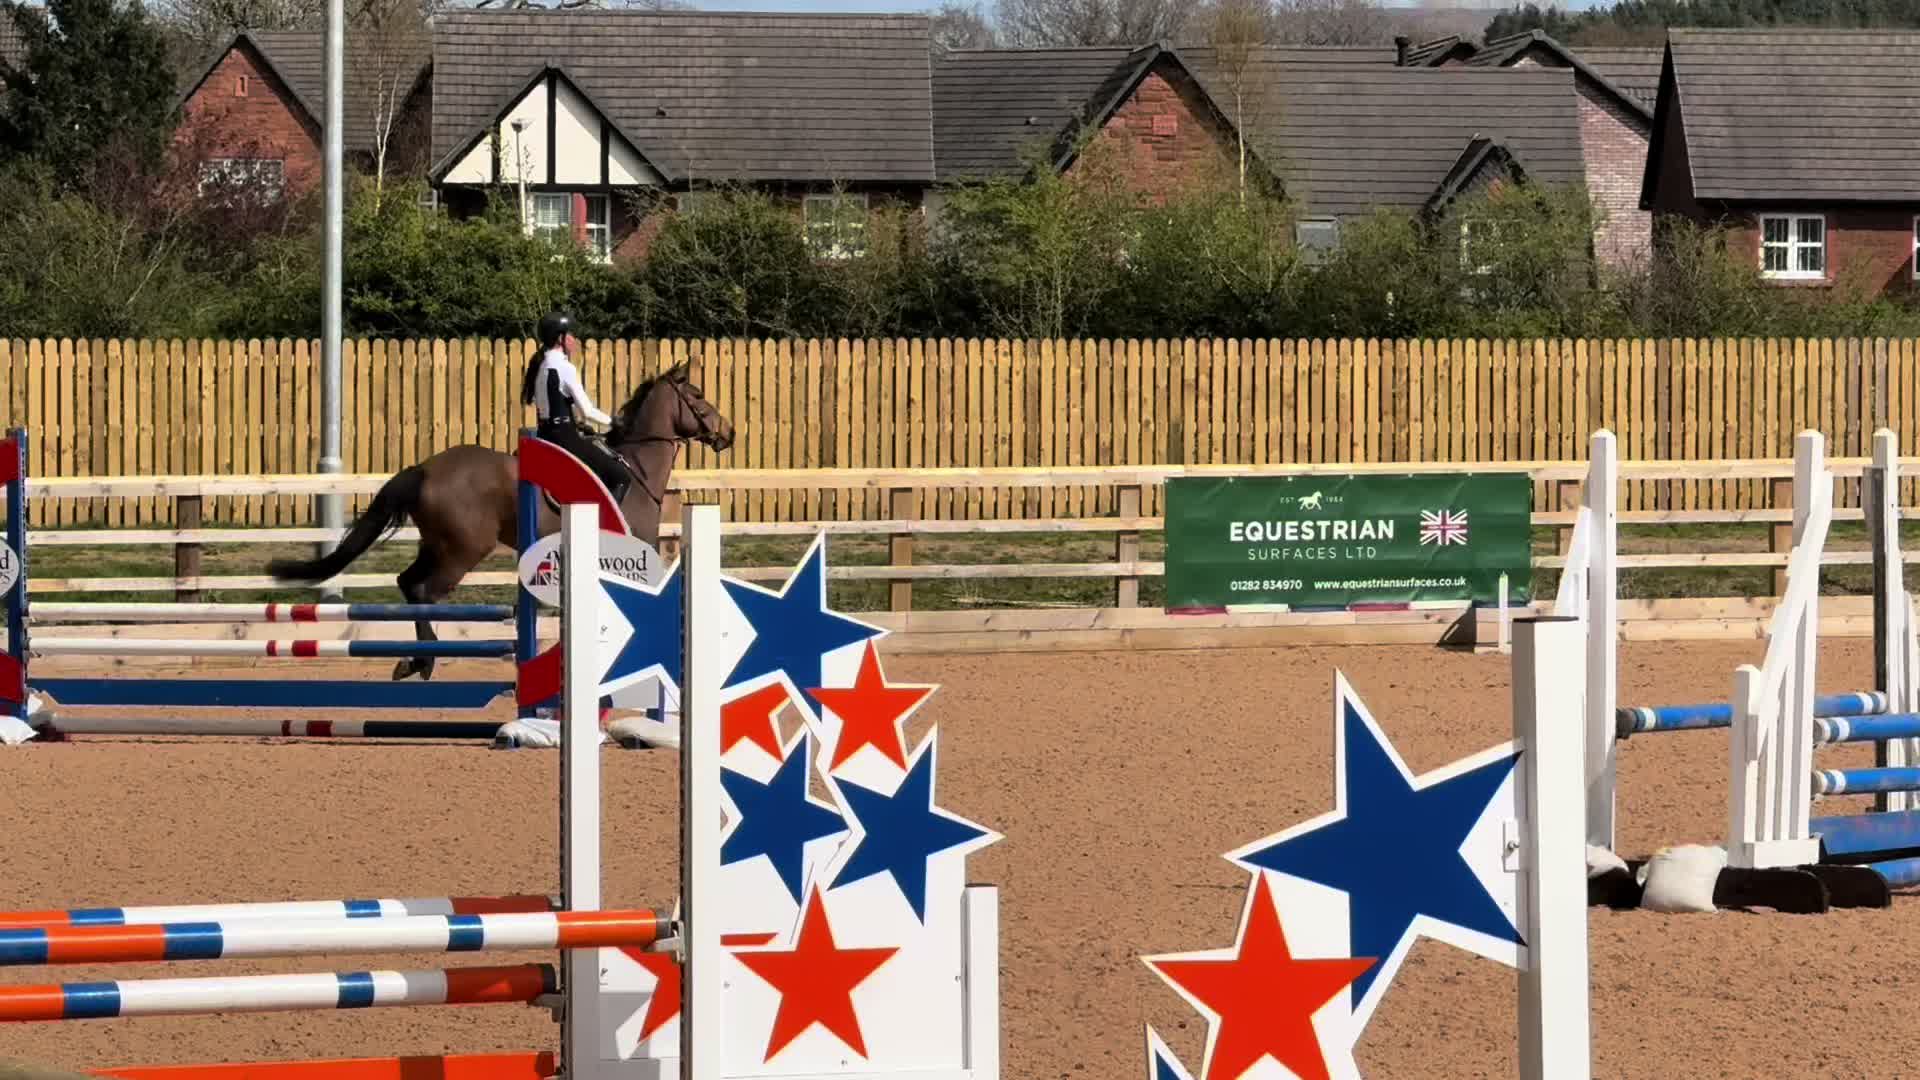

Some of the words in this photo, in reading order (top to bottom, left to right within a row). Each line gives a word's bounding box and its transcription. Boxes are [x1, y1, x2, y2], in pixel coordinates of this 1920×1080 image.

[1229, 519, 1395, 543] EQUESTRIAN
[1248, 547, 1338, 561] SURFACES
[1345, 546, 1377, 560] LTD
[1230, 580, 1261, 591] 01282
[1262, 578, 1303, 591] 834970
[1313, 576, 1467, 590] www.equestriansurfaces.co.uk
